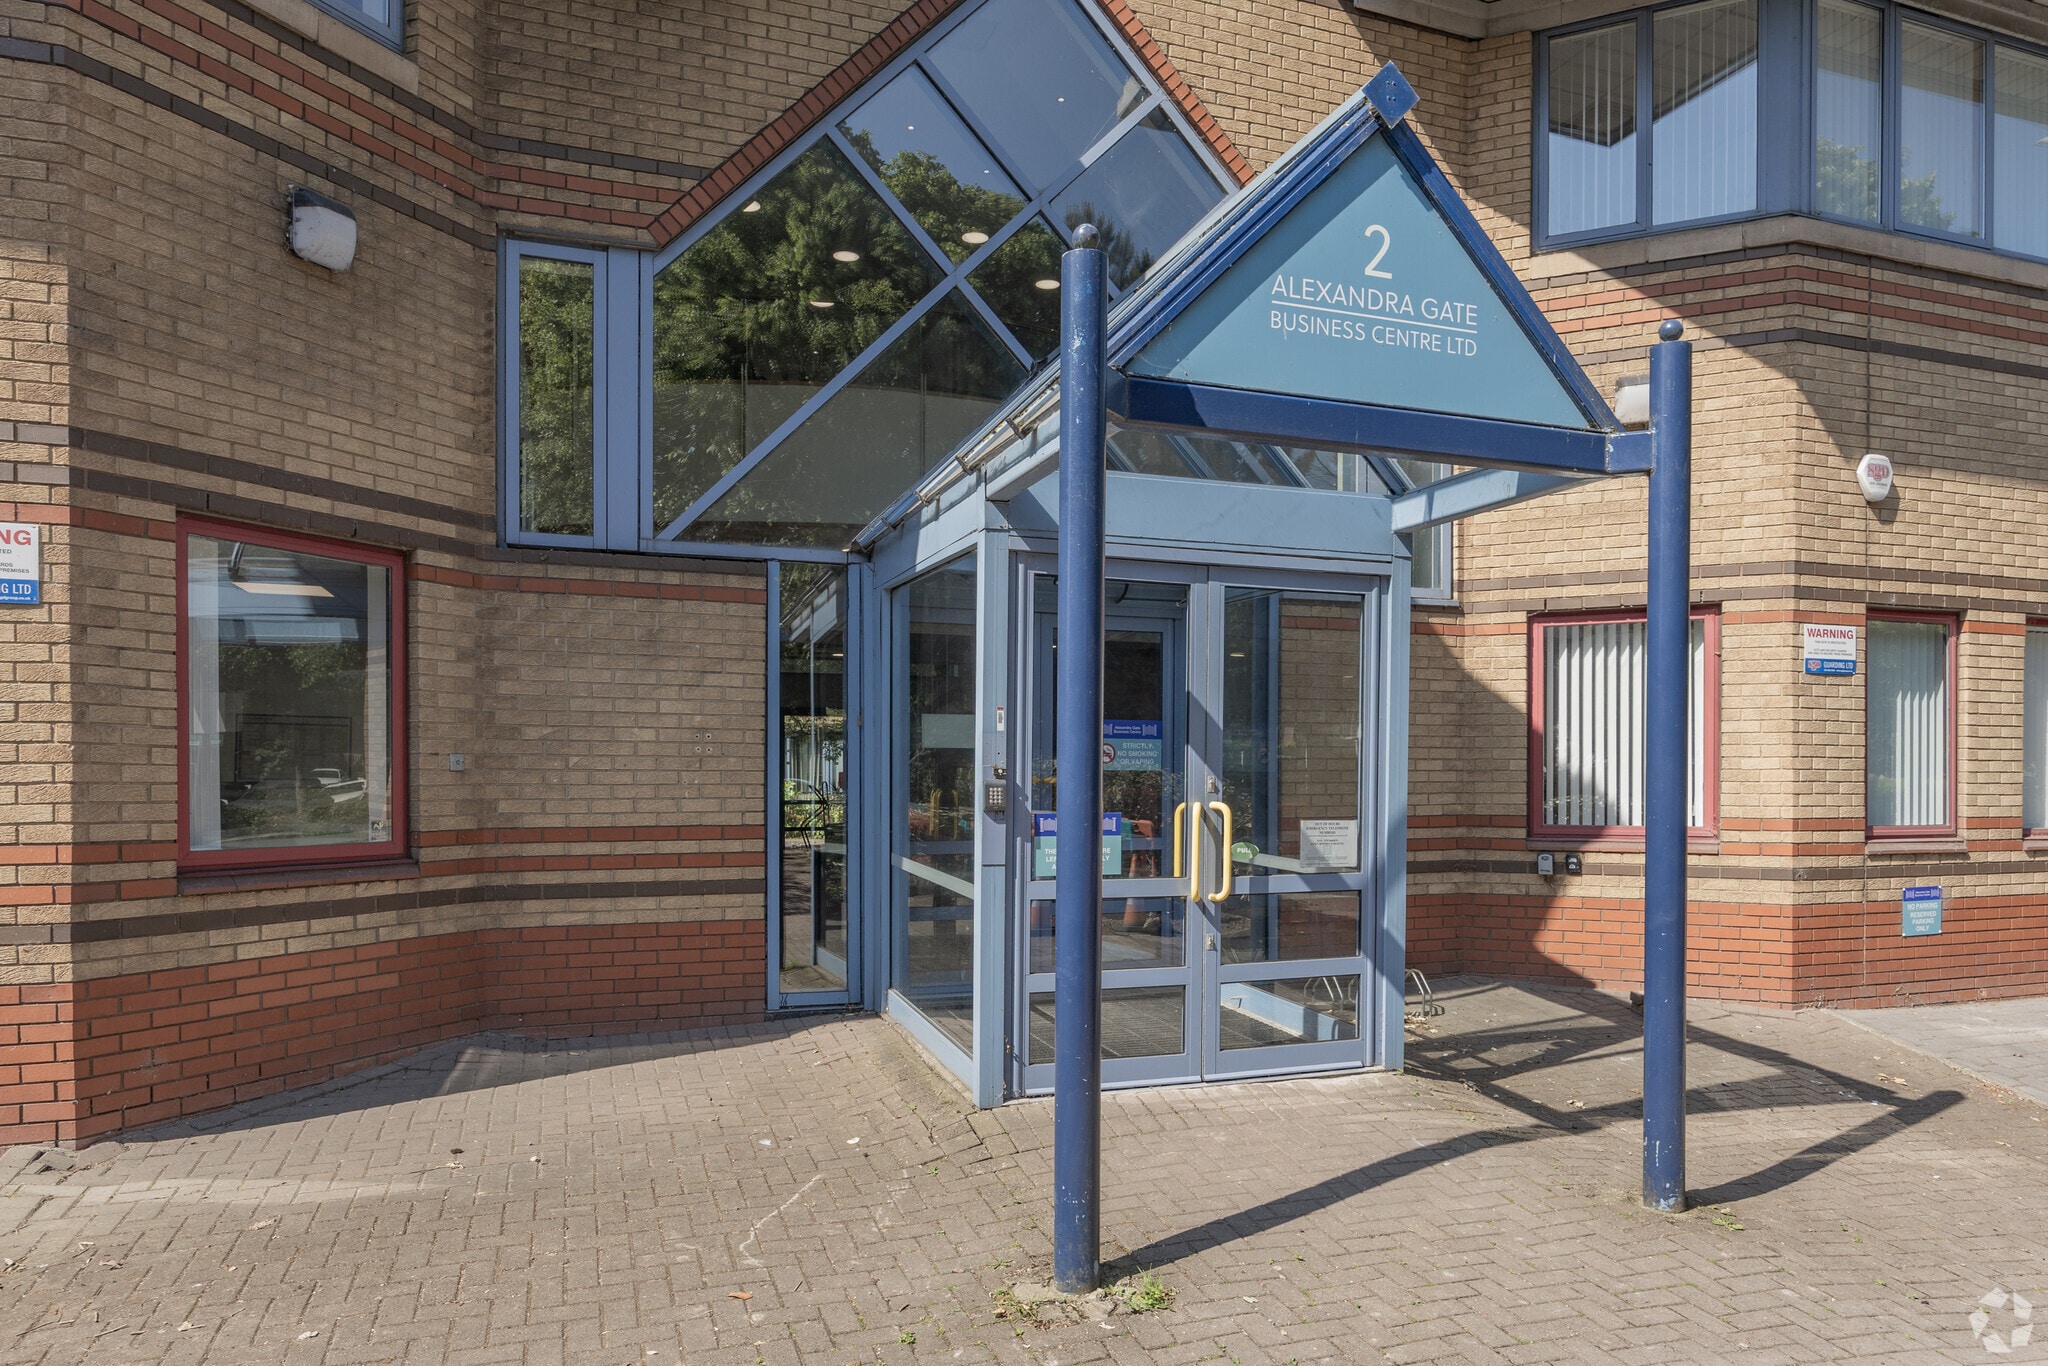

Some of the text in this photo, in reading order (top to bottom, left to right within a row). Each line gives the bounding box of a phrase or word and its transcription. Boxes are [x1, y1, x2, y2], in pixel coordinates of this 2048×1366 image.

[1364, 224, 1393, 279] 2
[1271, 274, 1478, 326] ALEXANDRA GATE
[1270, 310, 1477, 357] BUSINESS CENTRE LTD
[12, 583, 32, 595] LTD
[1807, 628, 1854, 640] WARNING
